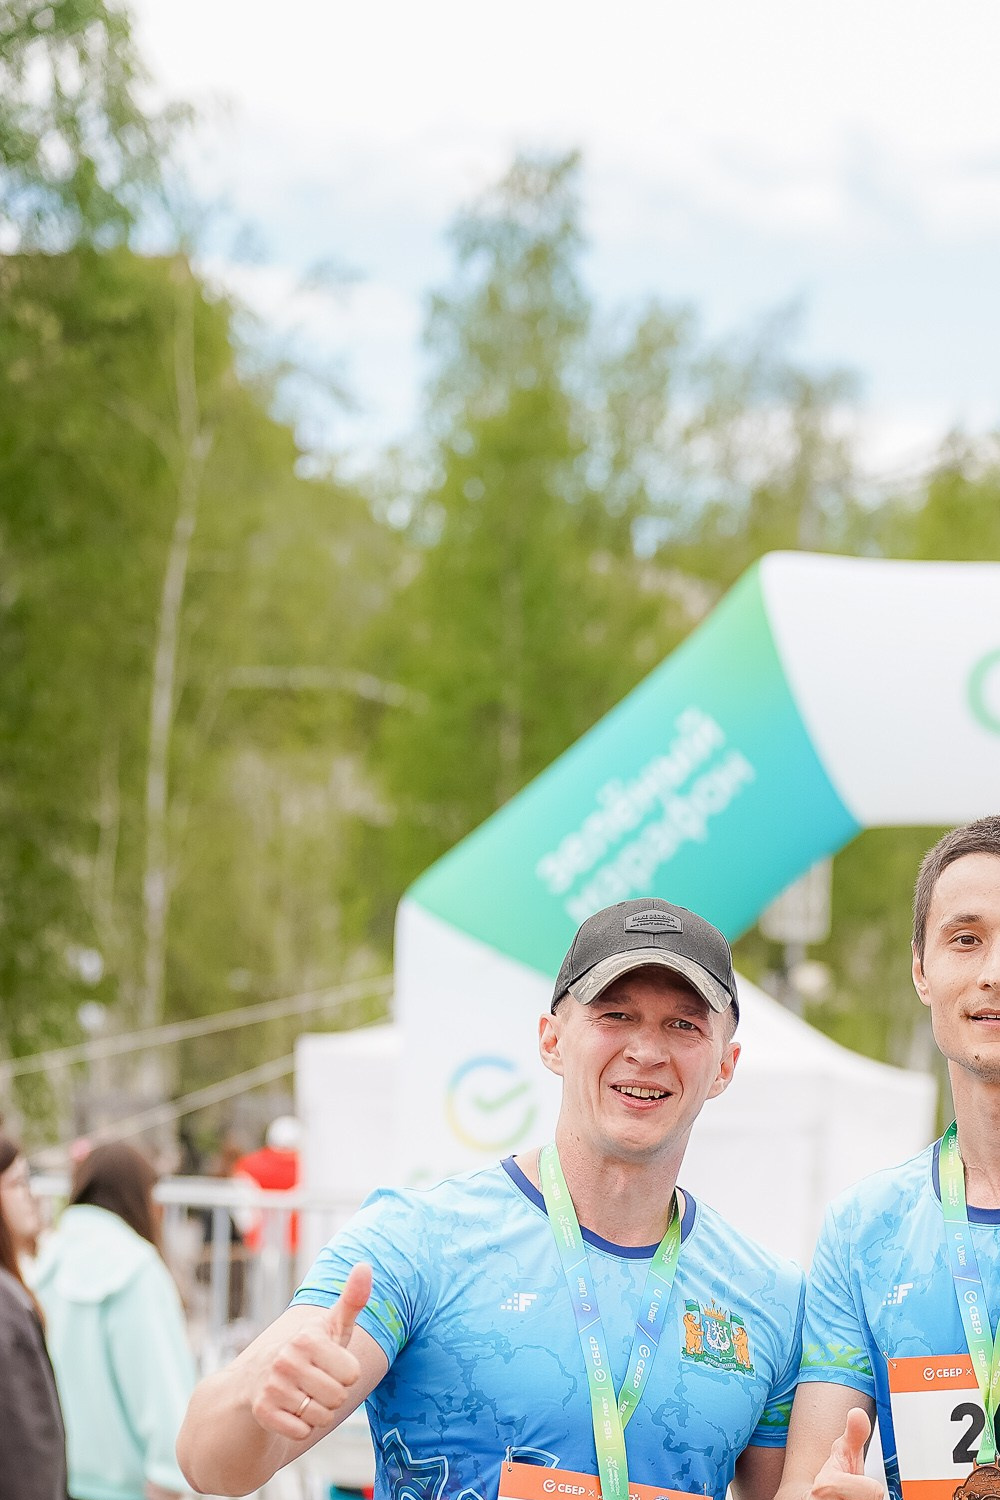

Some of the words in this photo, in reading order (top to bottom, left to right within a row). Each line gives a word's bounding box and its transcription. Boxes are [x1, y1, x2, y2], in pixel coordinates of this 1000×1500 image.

[956, 1245, 967, 1266] Utair
[577, 1277, 588, 1298] Utair
[647, 1301, 659, 1324] Utair
[969, 1305, 983, 1335] СБЕР
[589, 1336, 602, 1366] СБЕР
[977, 1348, 987, 1368] 185
[633, 1360, 646, 1389] СБЕР
[936, 1368, 963, 1378] СБЕР
[603, 1419, 613, 1440] 185
[557, 1483, 585, 1496] СБЕР
